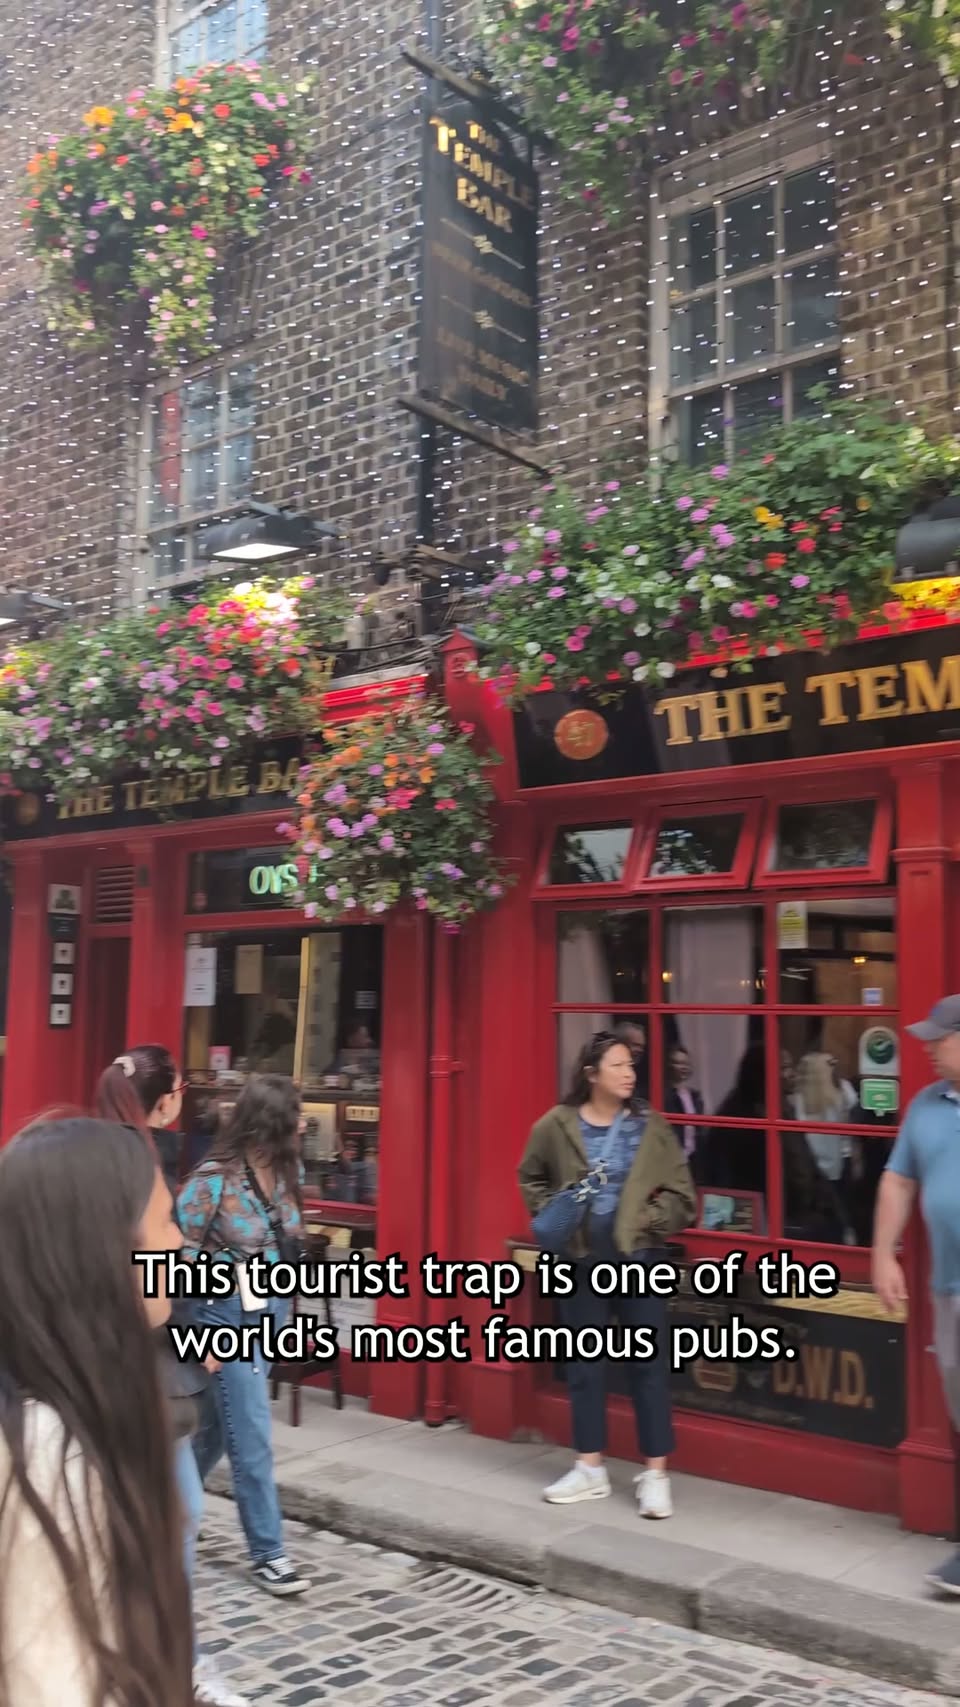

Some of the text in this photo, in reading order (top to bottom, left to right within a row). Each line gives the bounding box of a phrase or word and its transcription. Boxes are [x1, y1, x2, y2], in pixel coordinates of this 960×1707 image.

[429, 117, 534, 210] TEMPLE
[456, 176, 513, 233] BAR
[654, 654, 960, 746] THE TEM
[121, 765, 249, 811] TEMPLE
[256, 757, 300, 794] BA
